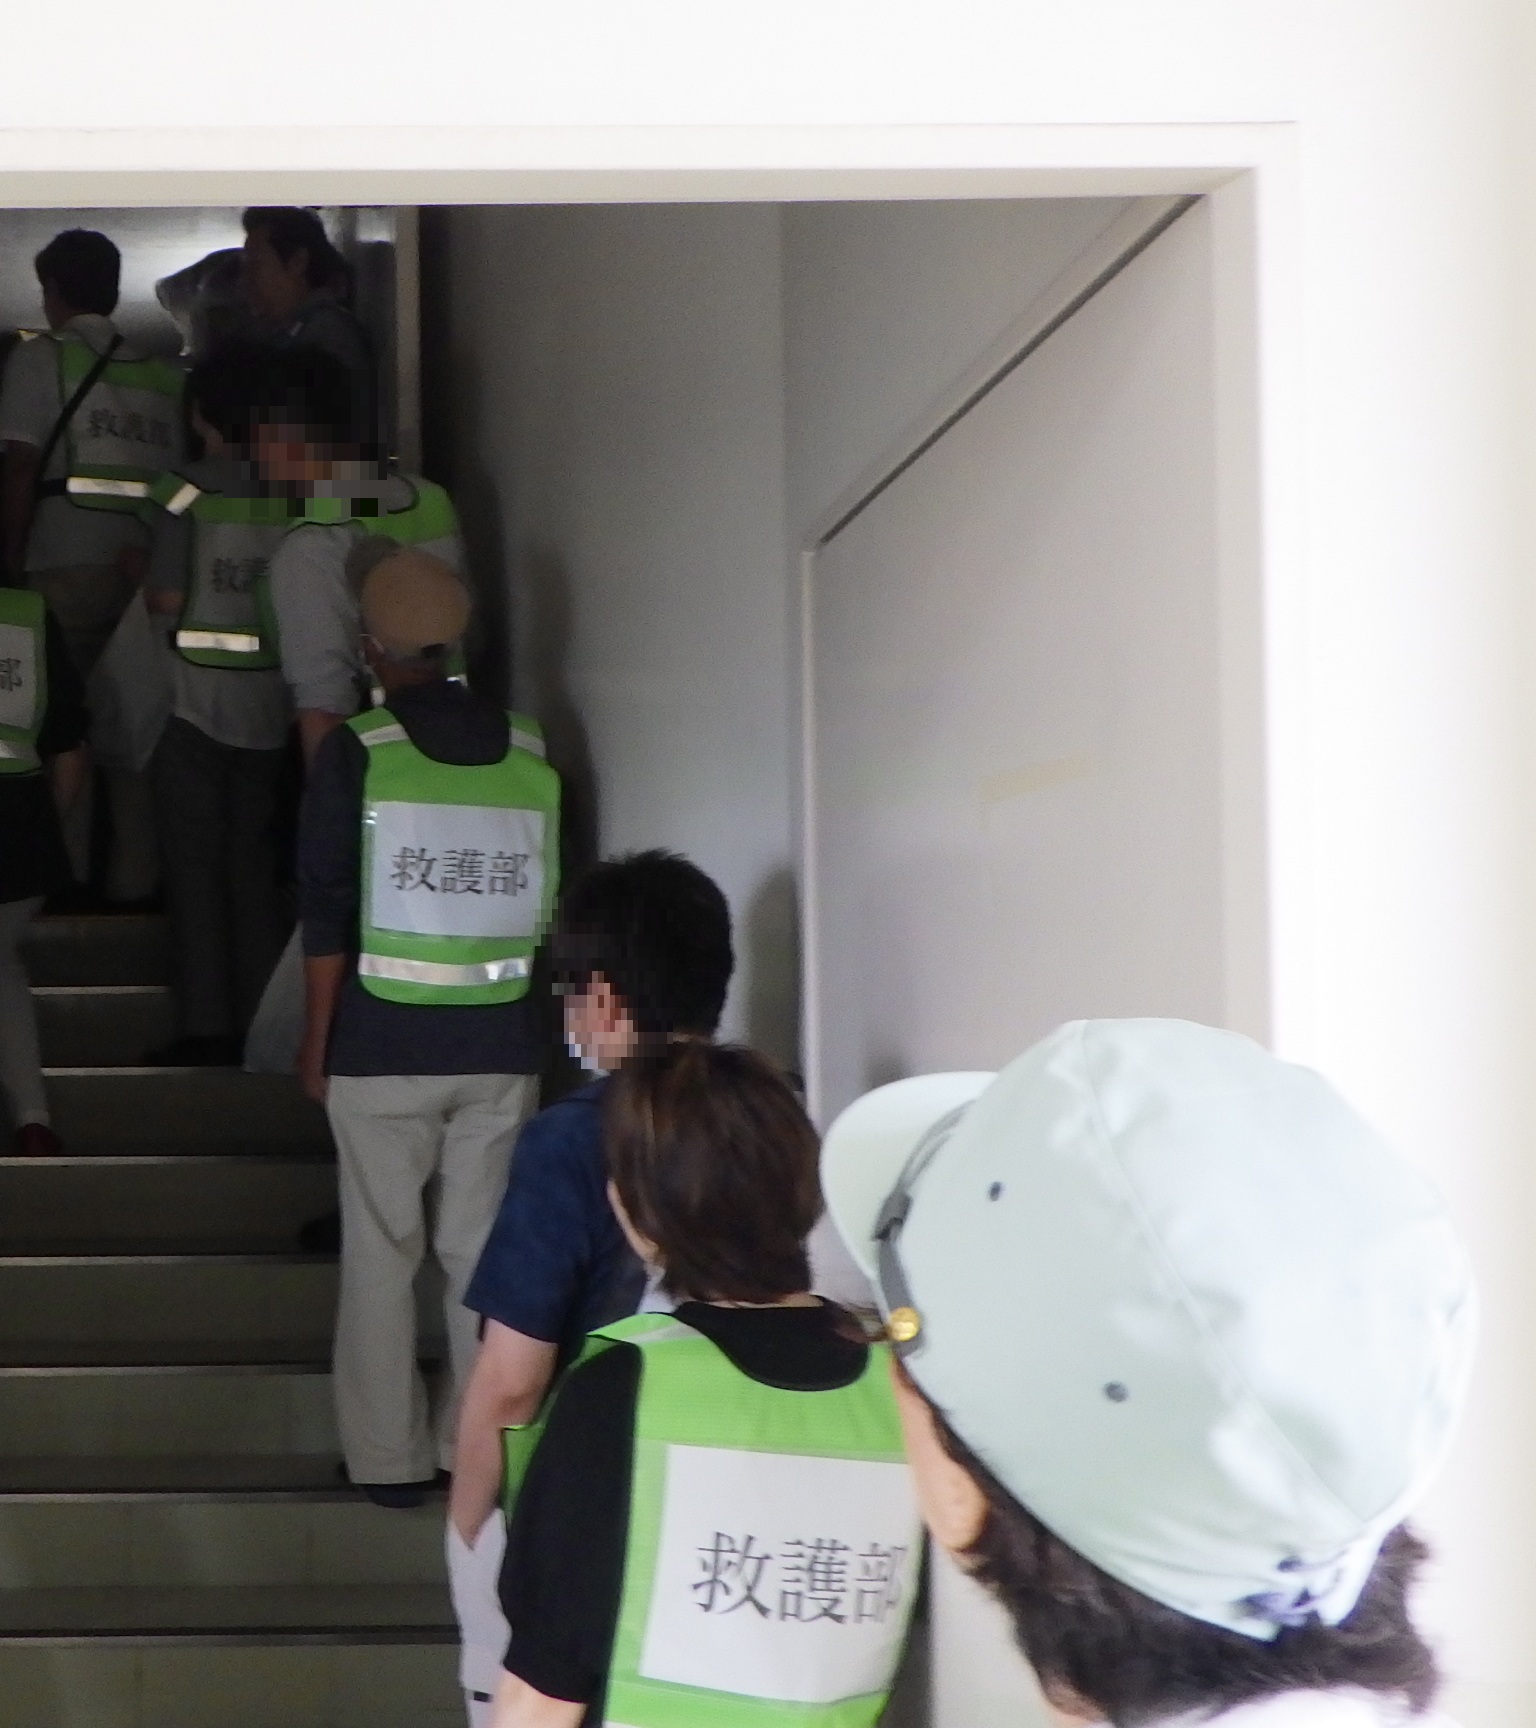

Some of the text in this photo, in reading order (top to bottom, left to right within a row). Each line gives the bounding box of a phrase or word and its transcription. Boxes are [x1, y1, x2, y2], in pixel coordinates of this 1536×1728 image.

[390, 846, 528, 897] 救護部
[692, 1531, 908, 1625] 救護部
